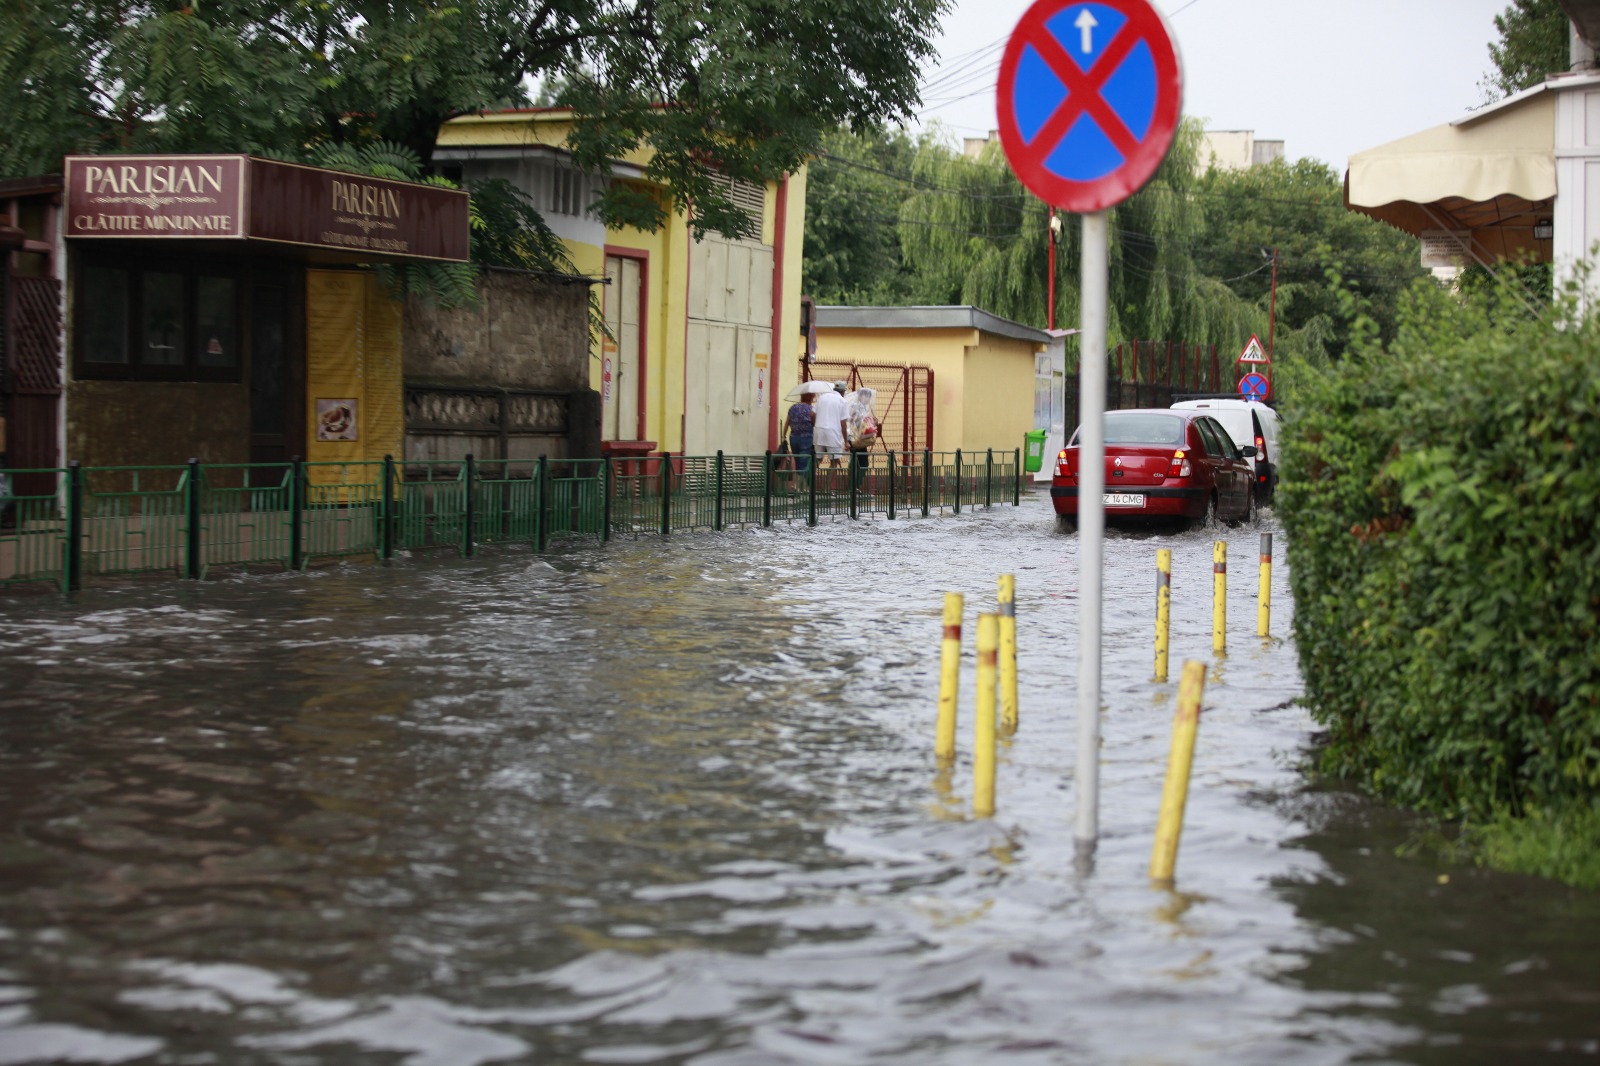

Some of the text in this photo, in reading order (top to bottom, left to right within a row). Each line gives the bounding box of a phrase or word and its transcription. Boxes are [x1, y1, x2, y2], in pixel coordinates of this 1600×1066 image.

[85, 165, 223, 194] PARISIAN
[332, 180, 401, 218] PARISIAN
[143, 215, 231, 231] MINUNATE
[1112, 494, 1121, 504] 14
[1122, 494, 1143, 504] CMG
